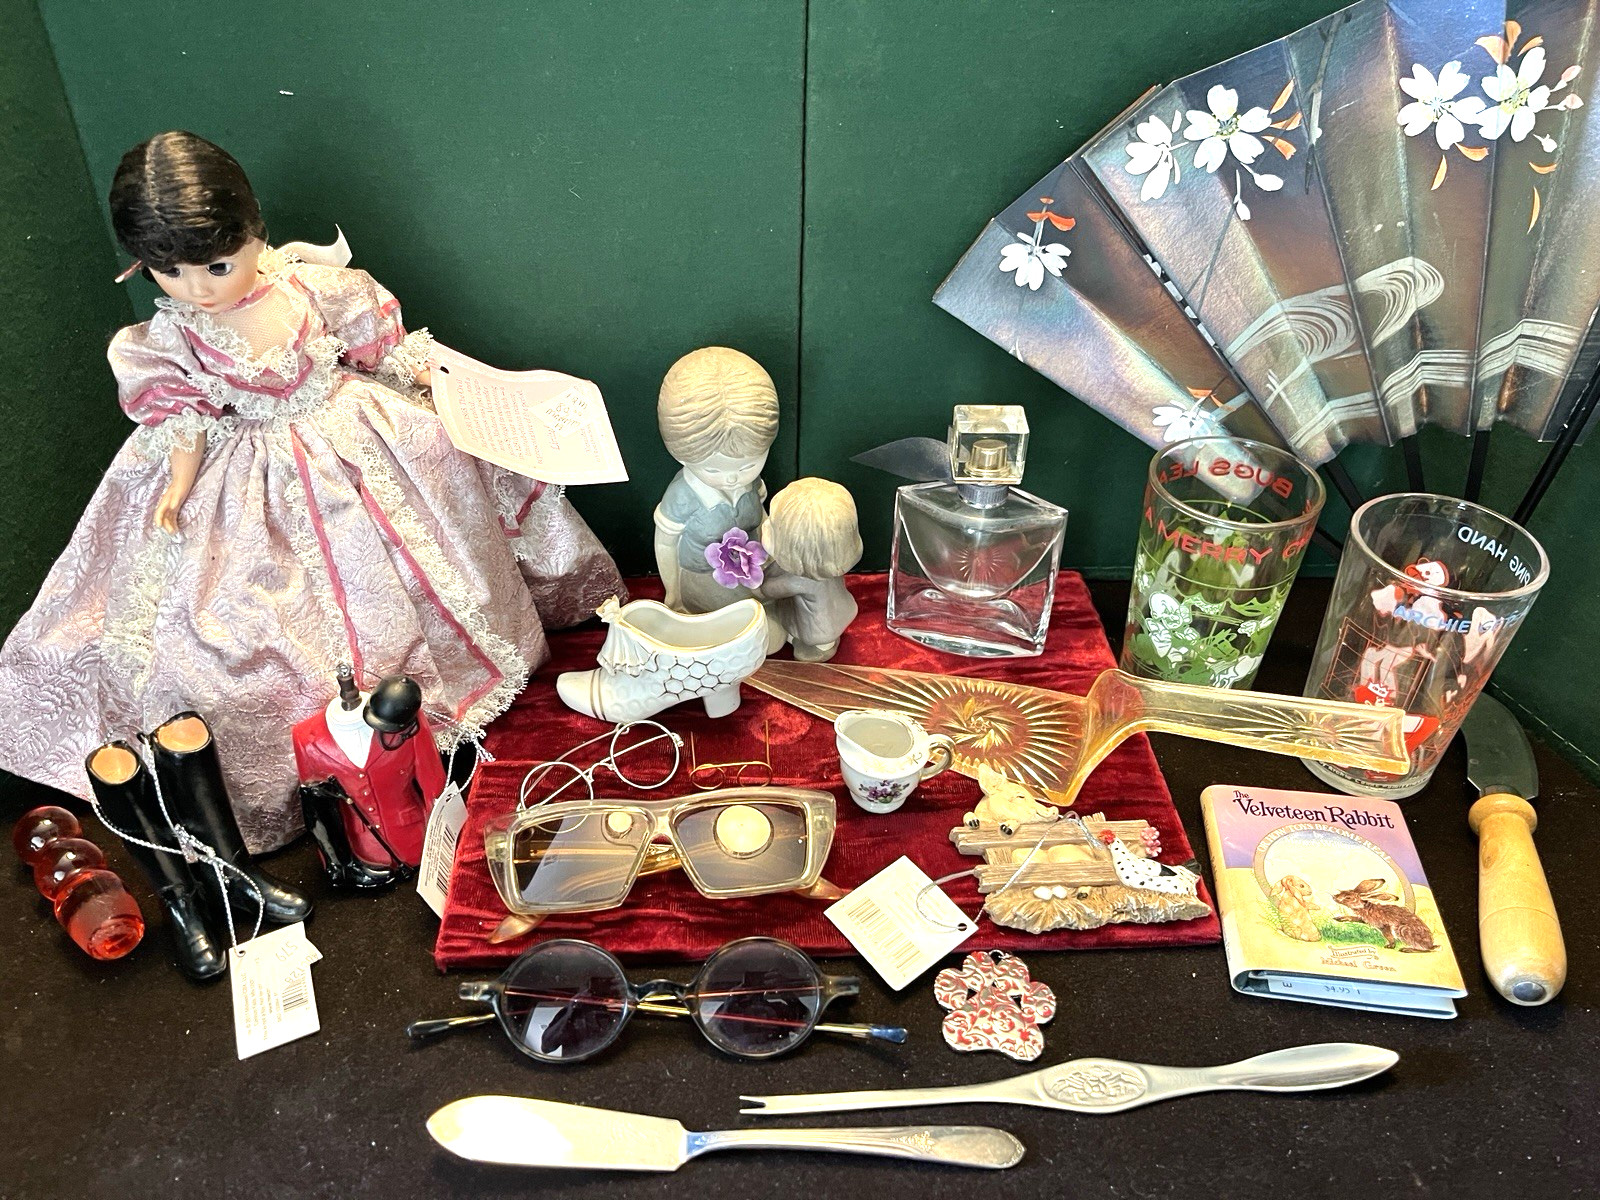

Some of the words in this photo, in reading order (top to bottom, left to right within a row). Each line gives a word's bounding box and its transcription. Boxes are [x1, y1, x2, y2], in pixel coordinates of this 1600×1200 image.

[1157, 519, 1273, 565] MERRY
[1392, 604, 1472, 634] ARCHIE
[1232, 789, 1250, 799] The
[1232, 798, 1327, 822] Velveteen
[1324, 805, 1395, 830] Rabbit
[1267, 826, 1289, 843] HOW
[1288, 823, 1316, 834] TOYS
[1315, 823, 1363, 842] BECOME
[1362, 839, 1392, 863] REAL
